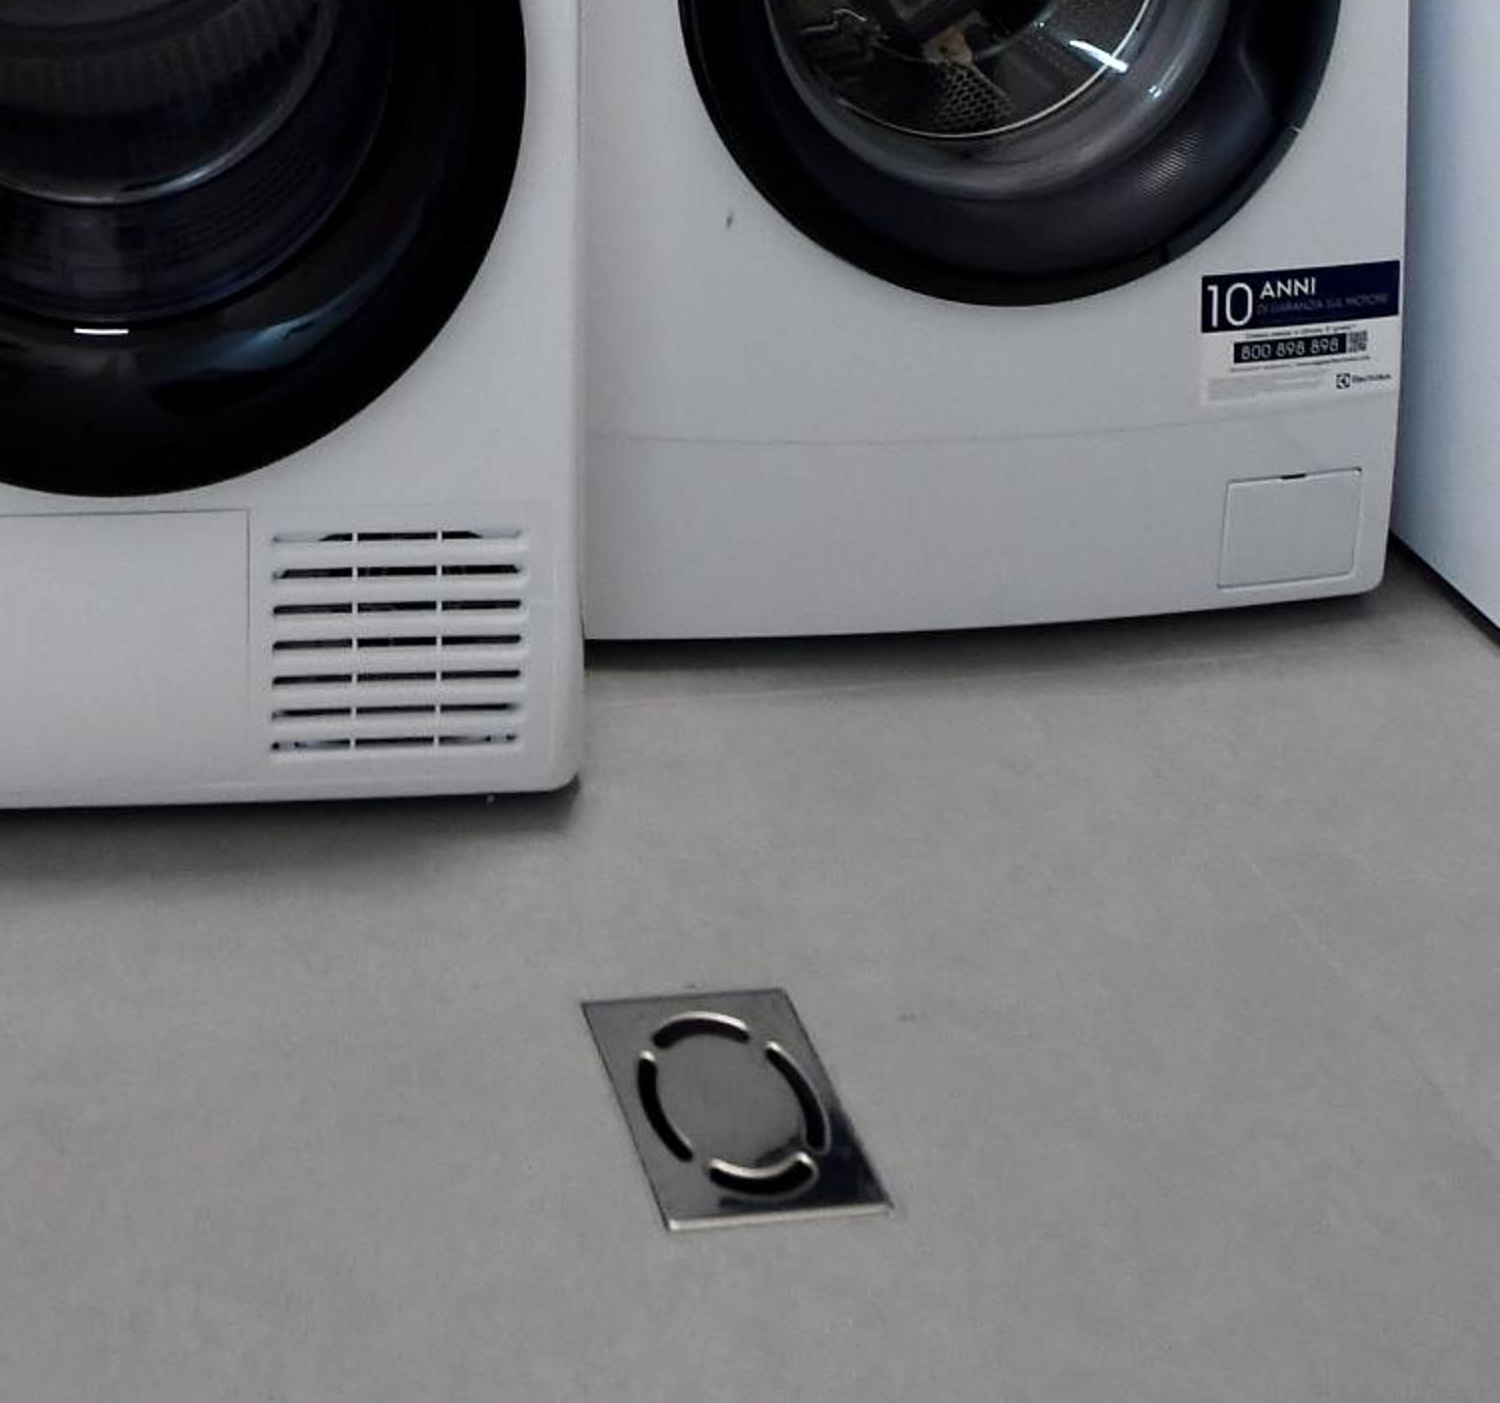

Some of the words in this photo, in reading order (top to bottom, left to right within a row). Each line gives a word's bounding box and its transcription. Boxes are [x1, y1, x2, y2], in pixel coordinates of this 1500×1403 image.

[1207, 281, 1253, 328] 10
[1260, 277, 1317, 299] ANNI
[1241, 343, 1272, 360] 800
[1276, 340, 1306, 358] 898
[1311, 337, 1340, 354] 898
